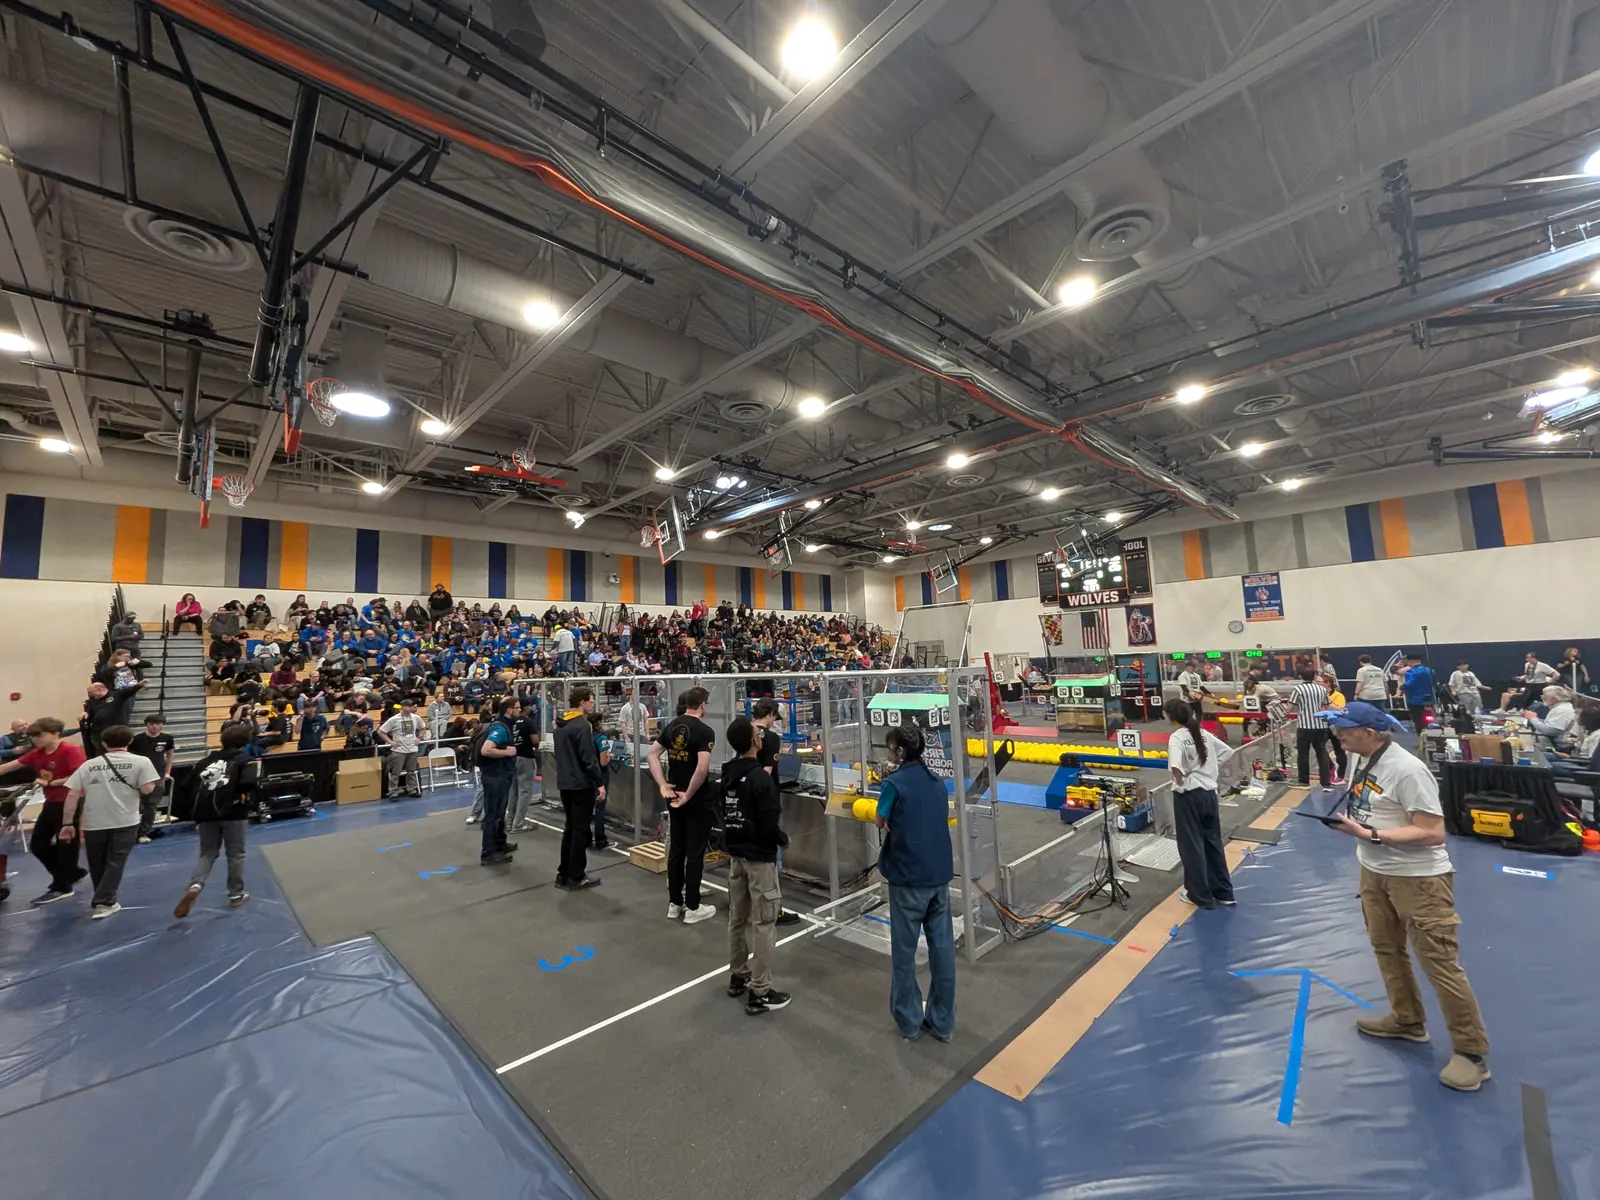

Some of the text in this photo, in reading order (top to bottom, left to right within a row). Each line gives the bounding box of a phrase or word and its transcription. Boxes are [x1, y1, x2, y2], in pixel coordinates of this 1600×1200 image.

[1123, 540, 1145, 551] HOOL
[1037, 554, 1058, 565] SEVE
[1067, 590, 1119, 607] WOLVES
[1117, 814, 1127, 829] 6
[537, 945, 597, 971] 3
